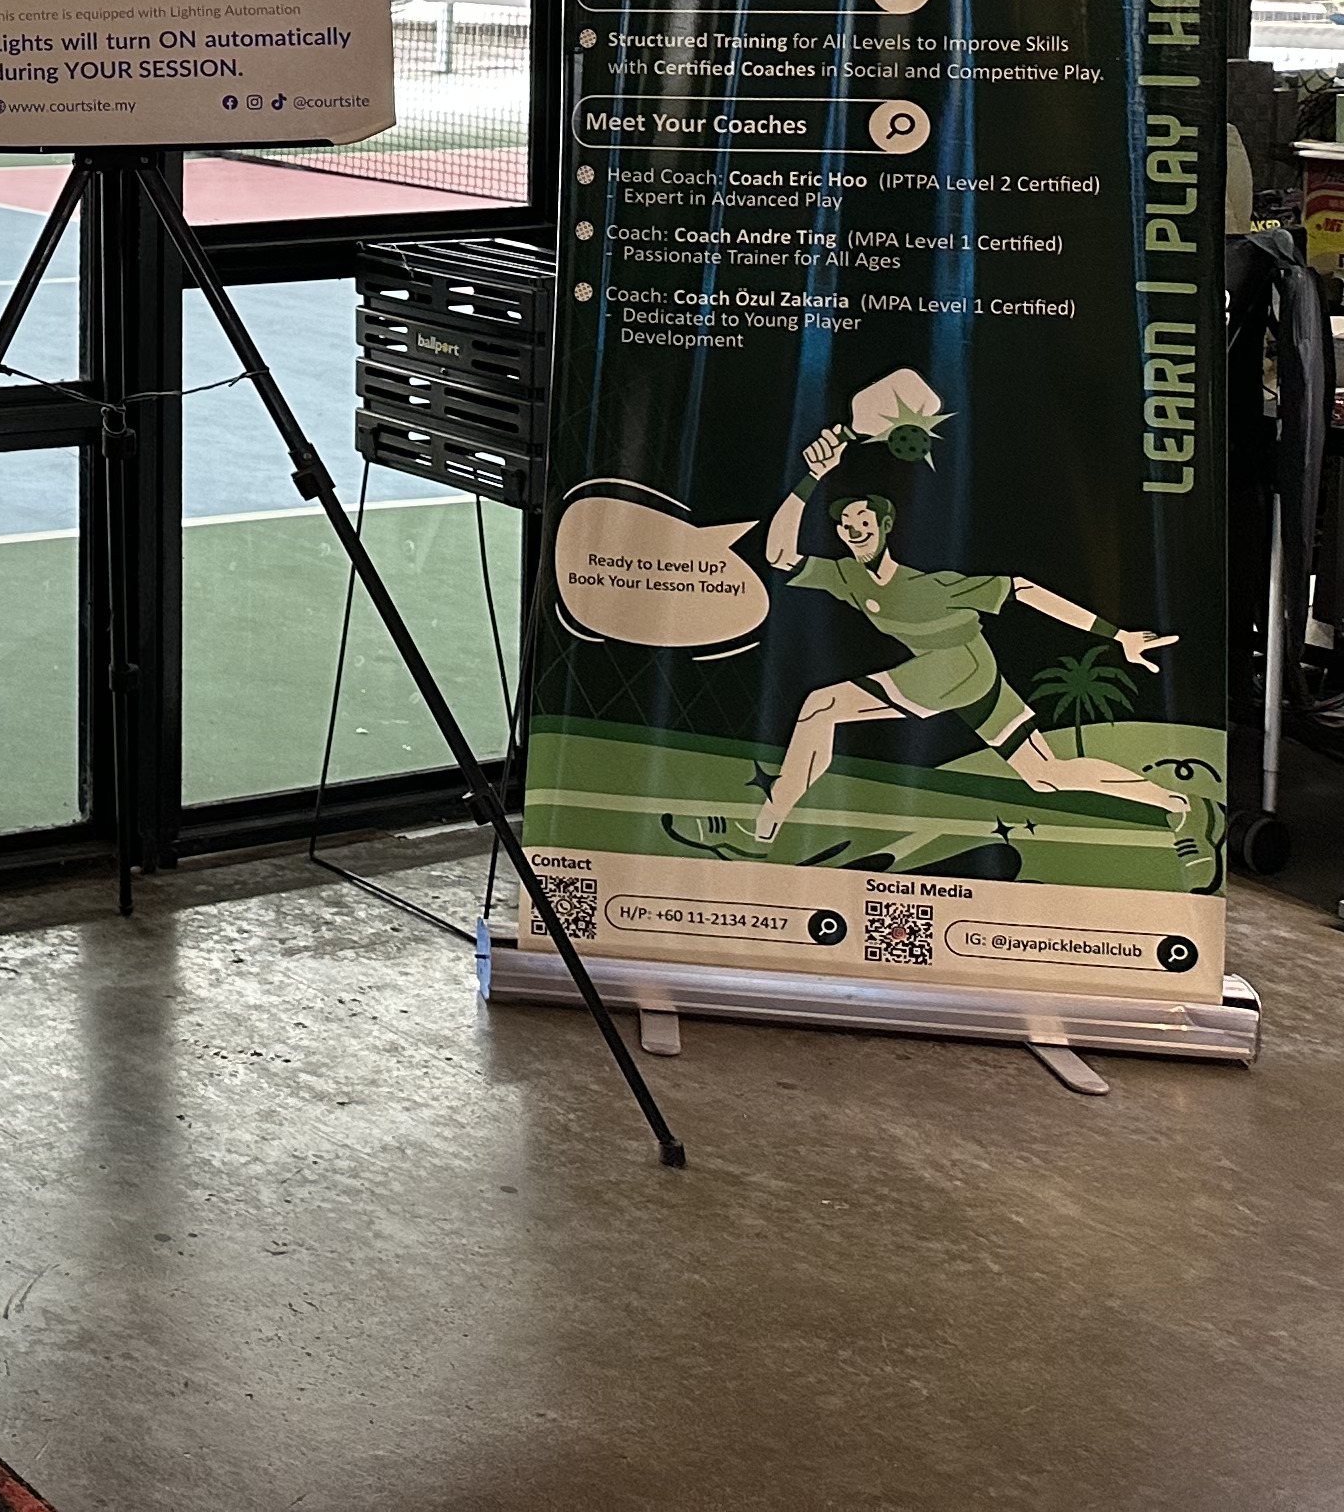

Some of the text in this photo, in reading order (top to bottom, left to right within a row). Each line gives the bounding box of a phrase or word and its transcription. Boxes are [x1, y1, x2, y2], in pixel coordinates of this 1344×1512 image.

[18, 10, 58, 21] centre
[62, 9, 72, 20] is
[75, 7, 134, 23] equipped
[139, 6, 166, 18] with
[170, 5, 221, 21] Lighting
[224, 3, 301, 18] Automation
[61, 32, 97, 50] will
[107, 33, 150, 50] turn
[159, 30, 196, 49] ON
[204, 27, 350, 51] automatically
[608, 31, 1068, 55] Structured Training for All Levels to Improve Skills
[64, 61, 132, 80] YOUR
[139, 59, 243, 78] SESSION.
[8, 94, 370, 114] www.courtsite.my @courtsite
[586, 112, 806, 135] Meet Your Coaches
[607, 168, 1100, 196] Head Coach: Coach Eric Hoo (IPTPA Level 2 Certified)
[1145, 114, 1197, 252] PLAY
[624, 189, 843, 211] Expert in Advanced Play
[1143, 324, 1195, 493] LEARN
[588, 554, 726, 576] Ready to Level Up?
[568, 572, 745, 596] Book Your Lesson Today!
[531, 853, 592, 871] Contact
[866, 878, 973, 899] Social Media
[619, 906, 788, 931] H/P: +60 11-2134 2417
[965, 932, 1142, 958] IG: @jayapickleballclub
